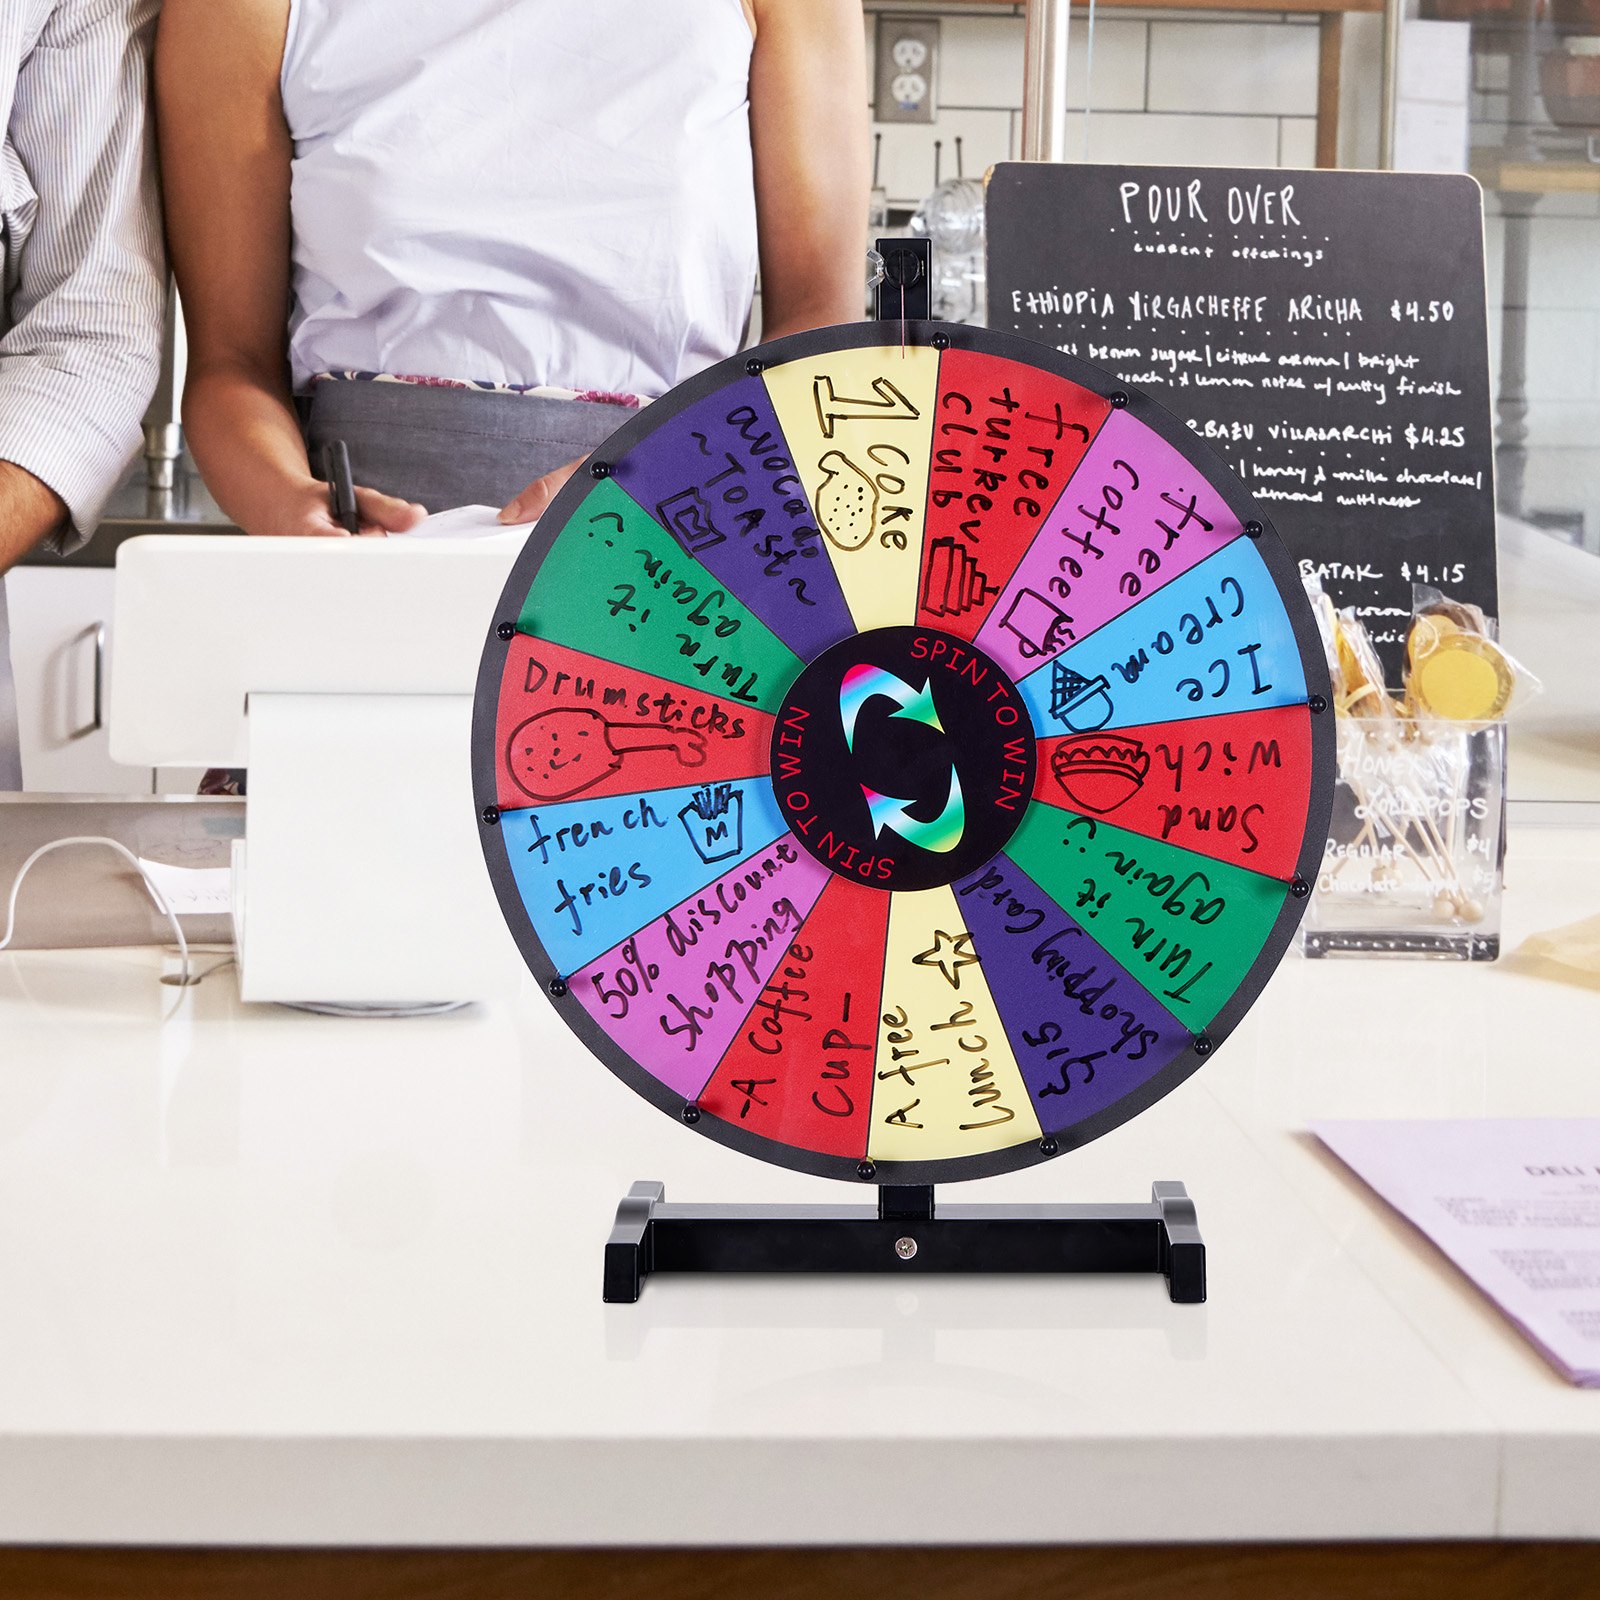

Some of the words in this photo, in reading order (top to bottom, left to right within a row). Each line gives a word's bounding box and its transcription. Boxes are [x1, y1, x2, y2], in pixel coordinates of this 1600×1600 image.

[1119, 179, 1208, 223] POUR
[1228, 184, 1301, 226] OVER
[1390, 299, 1454, 323] $4.50
[1195, 373, 1254, 388] lemon
[1396, 376, 1462, 396] finish
[1358, 353, 1420, 374] bright
[1013, 403, 1090, 518] free
[1404, 423, 1465, 450] $4.25
[1253, 463, 1306, 484] honey
[1332, 468, 1388, 483] milk
[1119, 492, 1214, 597] free
[635, 549, 742, 637] again
[1299, 559, 1383, 582] BATAK
[1401, 562, 1466, 583] $4.15
[607, 584, 650, 632] it
[671, 633, 759, 703] Turn
[911, 637, 988, 686] SPIN
[1176, 643, 1272, 702] Ice
[987, 681, 1019, 726] TO
[778, 706, 811, 780] WIN
[994, 737, 1027, 811] WIN
[787, 791, 818, 836] TO
[817, 831, 895, 880] SPIN
[1467, 833, 1490, 862] $4
[554, 862, 652, 936] fries
[1075, 878, 1112, 918] it
[1105, 851, 1226, 925] again
[592, 937, 660, 1019] 50%
[663, 843, 798, 957] discount
[1125, 917, 1213, 1004] Turn
[878, 1005, 950, 1086] free
[1022, 1021, 1107, 1098] $15
[884, 1098, 923, 1129] A
